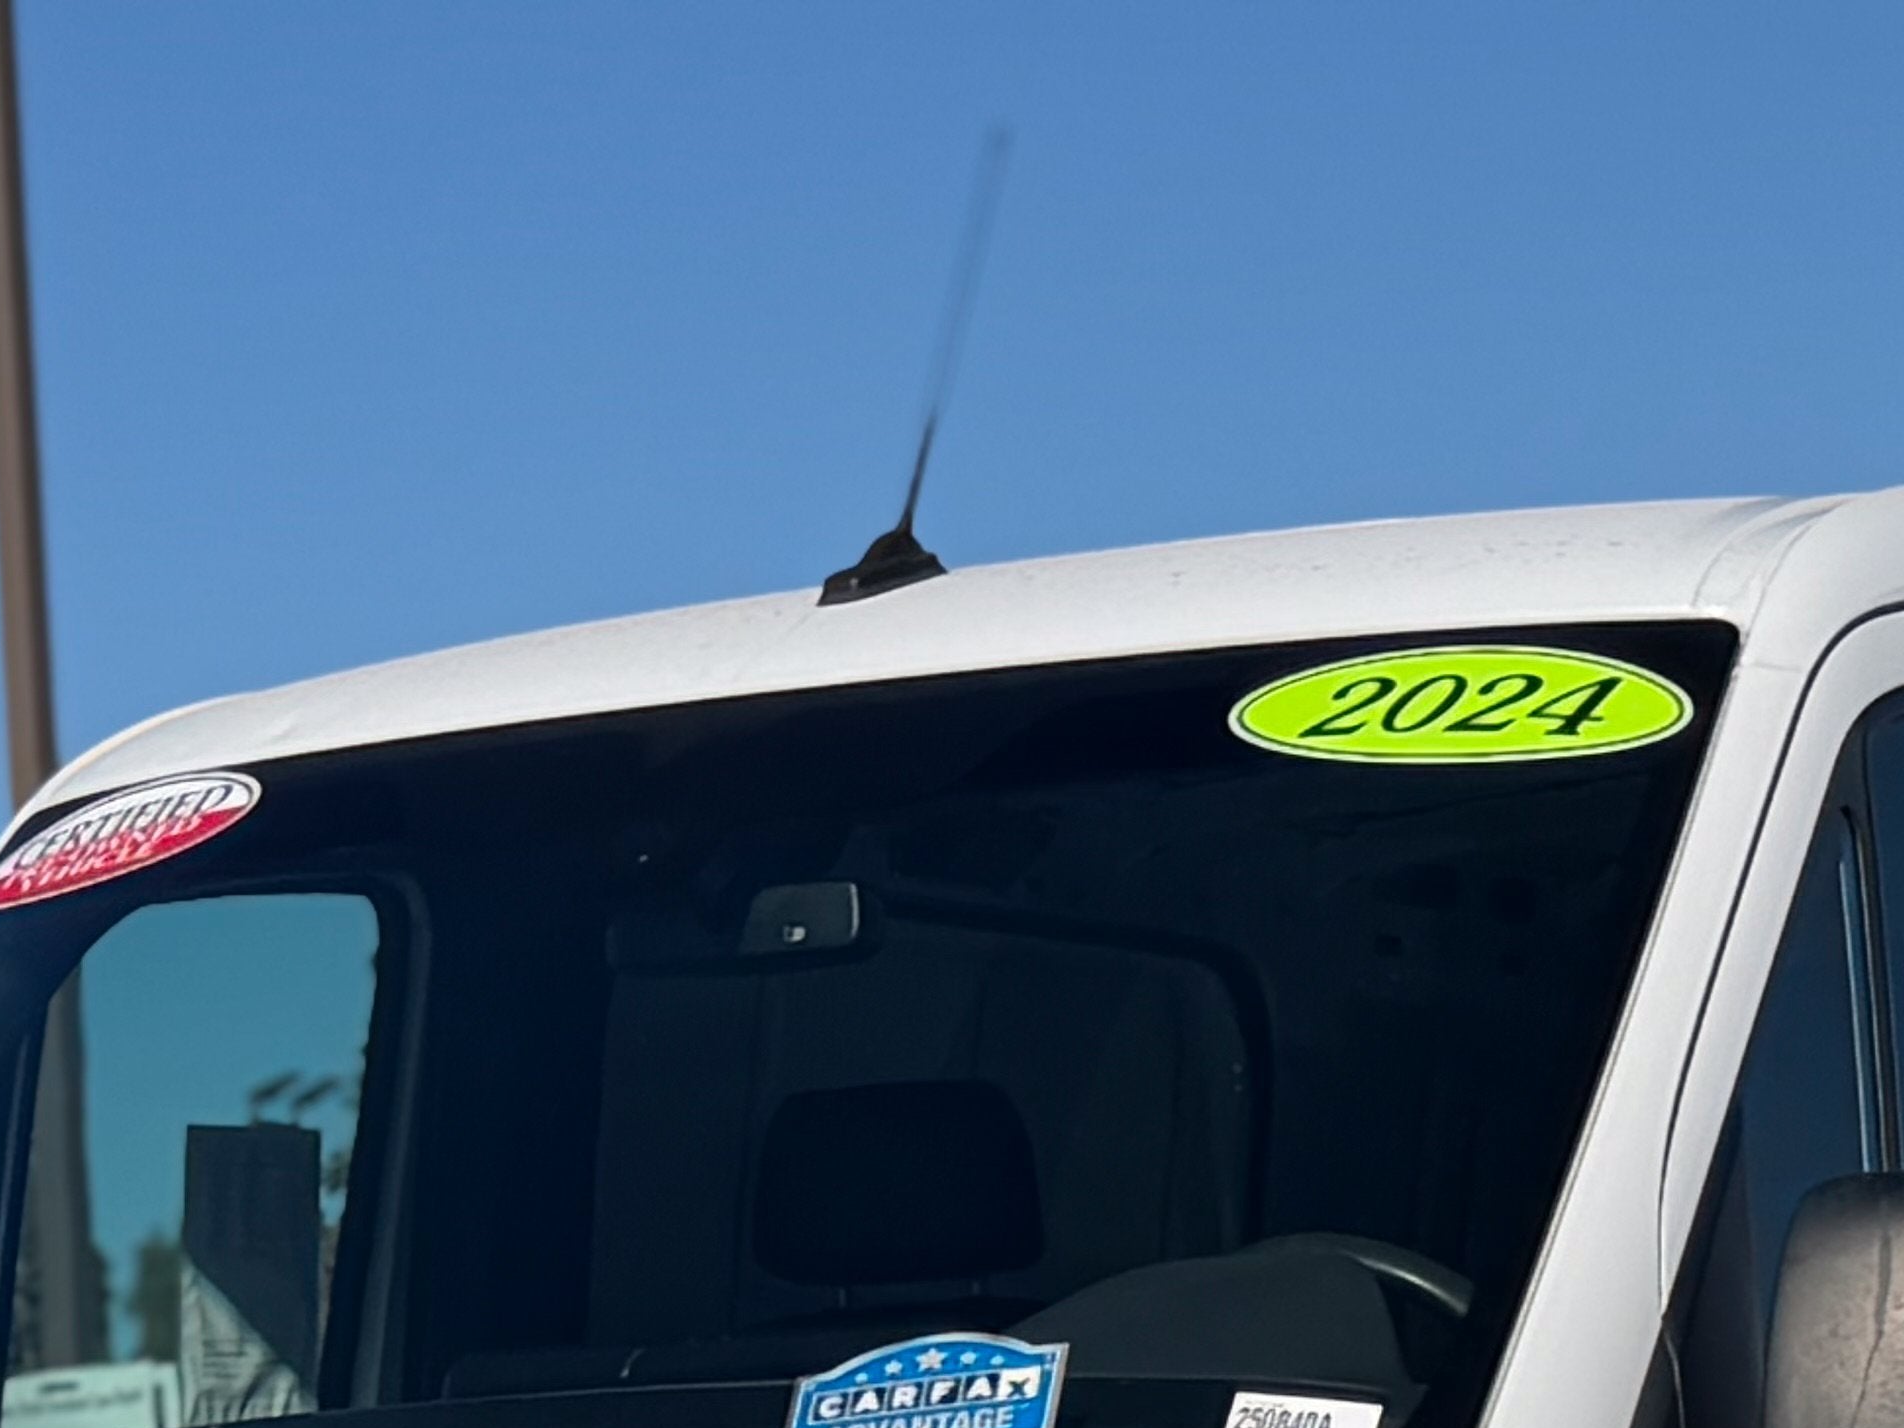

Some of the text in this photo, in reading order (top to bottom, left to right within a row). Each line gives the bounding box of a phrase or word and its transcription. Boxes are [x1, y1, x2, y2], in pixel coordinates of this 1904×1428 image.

[1297, 673, 1626, 739] 2024
[12, 783, 234, 871] CERTIFIED
[816, 1374, 1034, 1419] CARFAX
